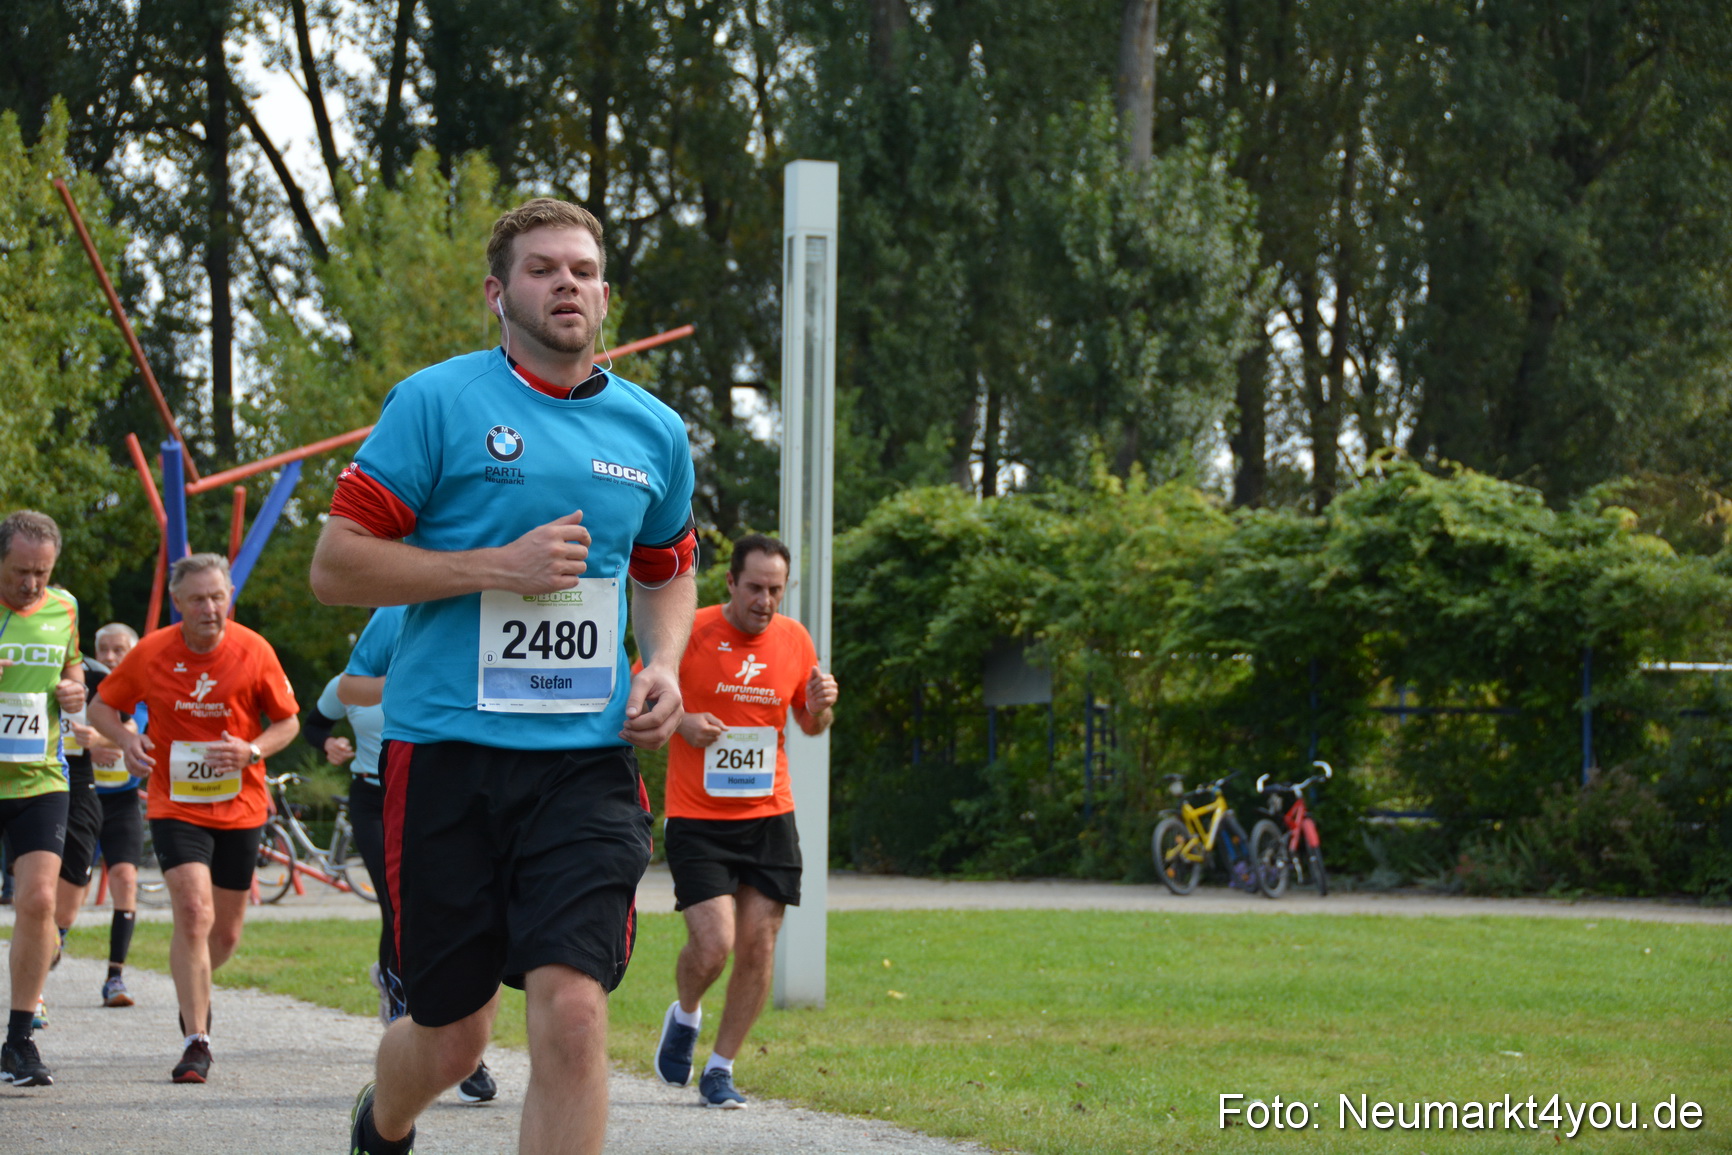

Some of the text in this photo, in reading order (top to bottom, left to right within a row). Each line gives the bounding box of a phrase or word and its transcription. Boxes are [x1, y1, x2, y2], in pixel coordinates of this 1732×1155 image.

[490, 426, 520, 440] BMW
[485, 466, 525, 478] PARTL
[592, 459, 651, 487] BOCK
[485, 476, 524, 485] Neumarkt
[537, 591, 582, 602] BOCK
[502, 620, 598, 660] 2480
[530, 675, 573, 689] Stefan
[715, 682, 775, 697] funrunners
[174, 700, 224, 712] funrunners
[733, 693, 782, 706] neumarkt
[191, 708, 232, 718] neumarkt
[716, 748, 764, 769] 2641
[728, 777, 755, 785] Homaid
